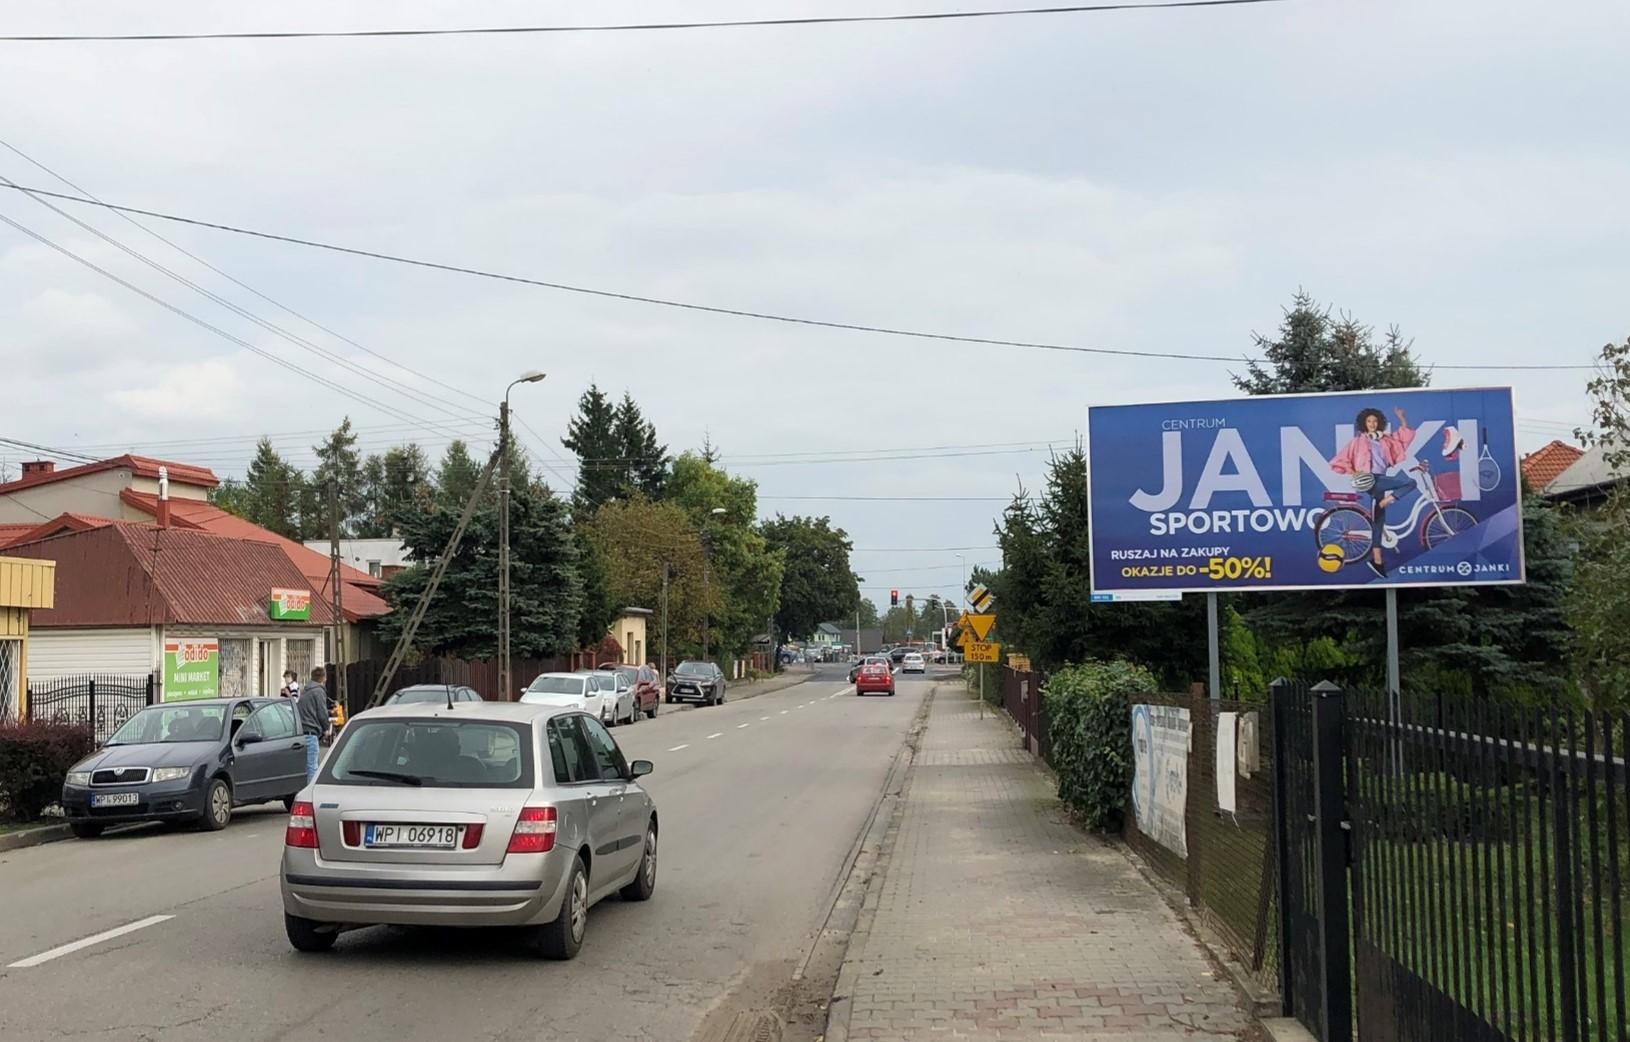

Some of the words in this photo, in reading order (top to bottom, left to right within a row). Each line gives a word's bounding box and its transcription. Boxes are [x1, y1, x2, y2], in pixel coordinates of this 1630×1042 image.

[1161, 417, 1226, 431] CENTRUM
[1129, 418, 1481, 512] JANKI
[1111, 550, 1158, 560] RUSZAJ
[1160, 549, 1179, 559] NA
[1181, 546, 1231, 558] ZAKUPY
[1121, 566, 1174, 578] OKAZJE
[1176, 565, 1197, 576] DO
[1199, 556, 1273, 580] -50%!
[1398, 564, 1455, 574] CENTRUM
[1473, 563, 1510, 573] JANKI
[184, 646, 209, 661] odido
[971, 644, 992, 652] STOP
[173, 671, 187, 682] MINI
[188, 671, 210, 682] MARKET
[375, 825, 401, 842] WPI
[408, 825, 454, 842] 06918
